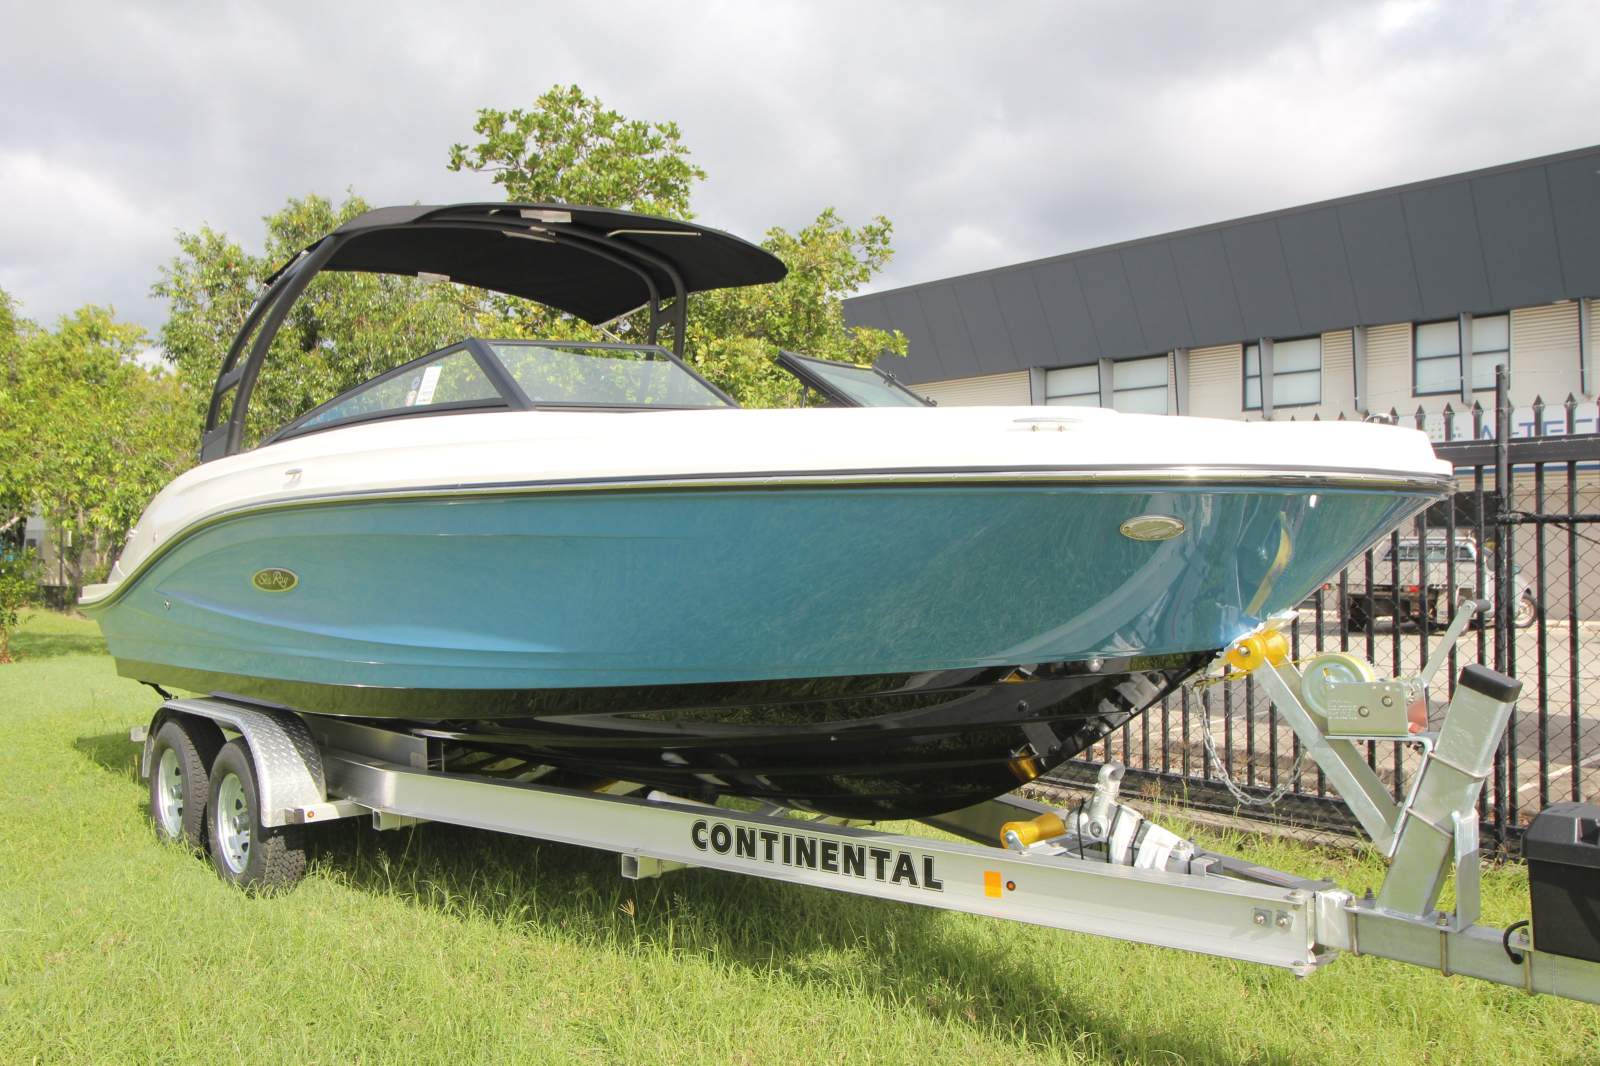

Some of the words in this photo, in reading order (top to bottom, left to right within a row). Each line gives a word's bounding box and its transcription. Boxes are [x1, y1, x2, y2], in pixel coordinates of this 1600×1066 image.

[259, 572, 272, 585] Sea
[272, 571, 289, 588] Ray
[691, 819, 944, 892] CONTINENTAL
